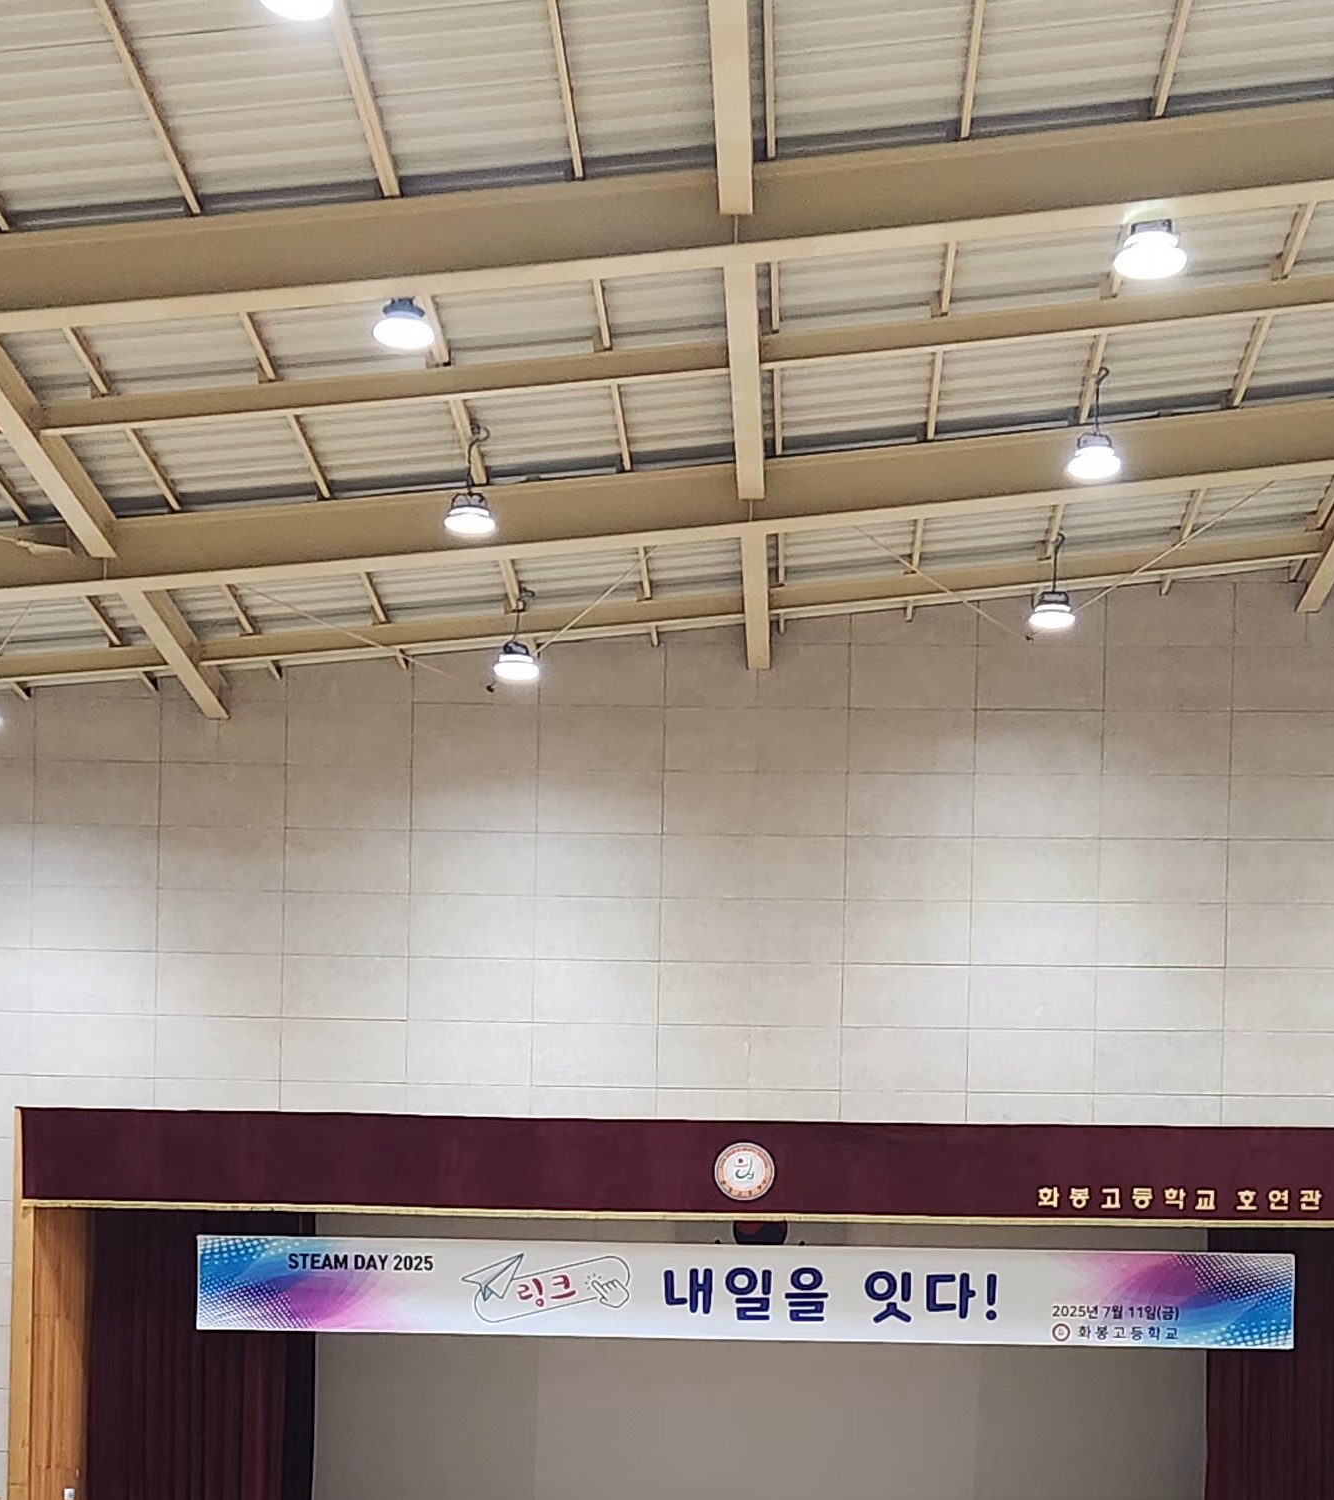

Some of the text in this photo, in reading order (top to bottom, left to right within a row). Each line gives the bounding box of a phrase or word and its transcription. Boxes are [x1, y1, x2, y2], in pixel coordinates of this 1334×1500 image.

[1038, 1187, 1323, 1211] 화봉고등학교 호연관
[288, 1253, 433, 1271] STEAM DAY 2025
[517, 1274, 577, 1307] 링크
[663, 1267, 998, 1323] 내일을 잇다!
[1052, 1305, 1180, 1321] 2025년 7월 11일(금)
[1077, 1325, 1179, 1340] 화봉고등학교
